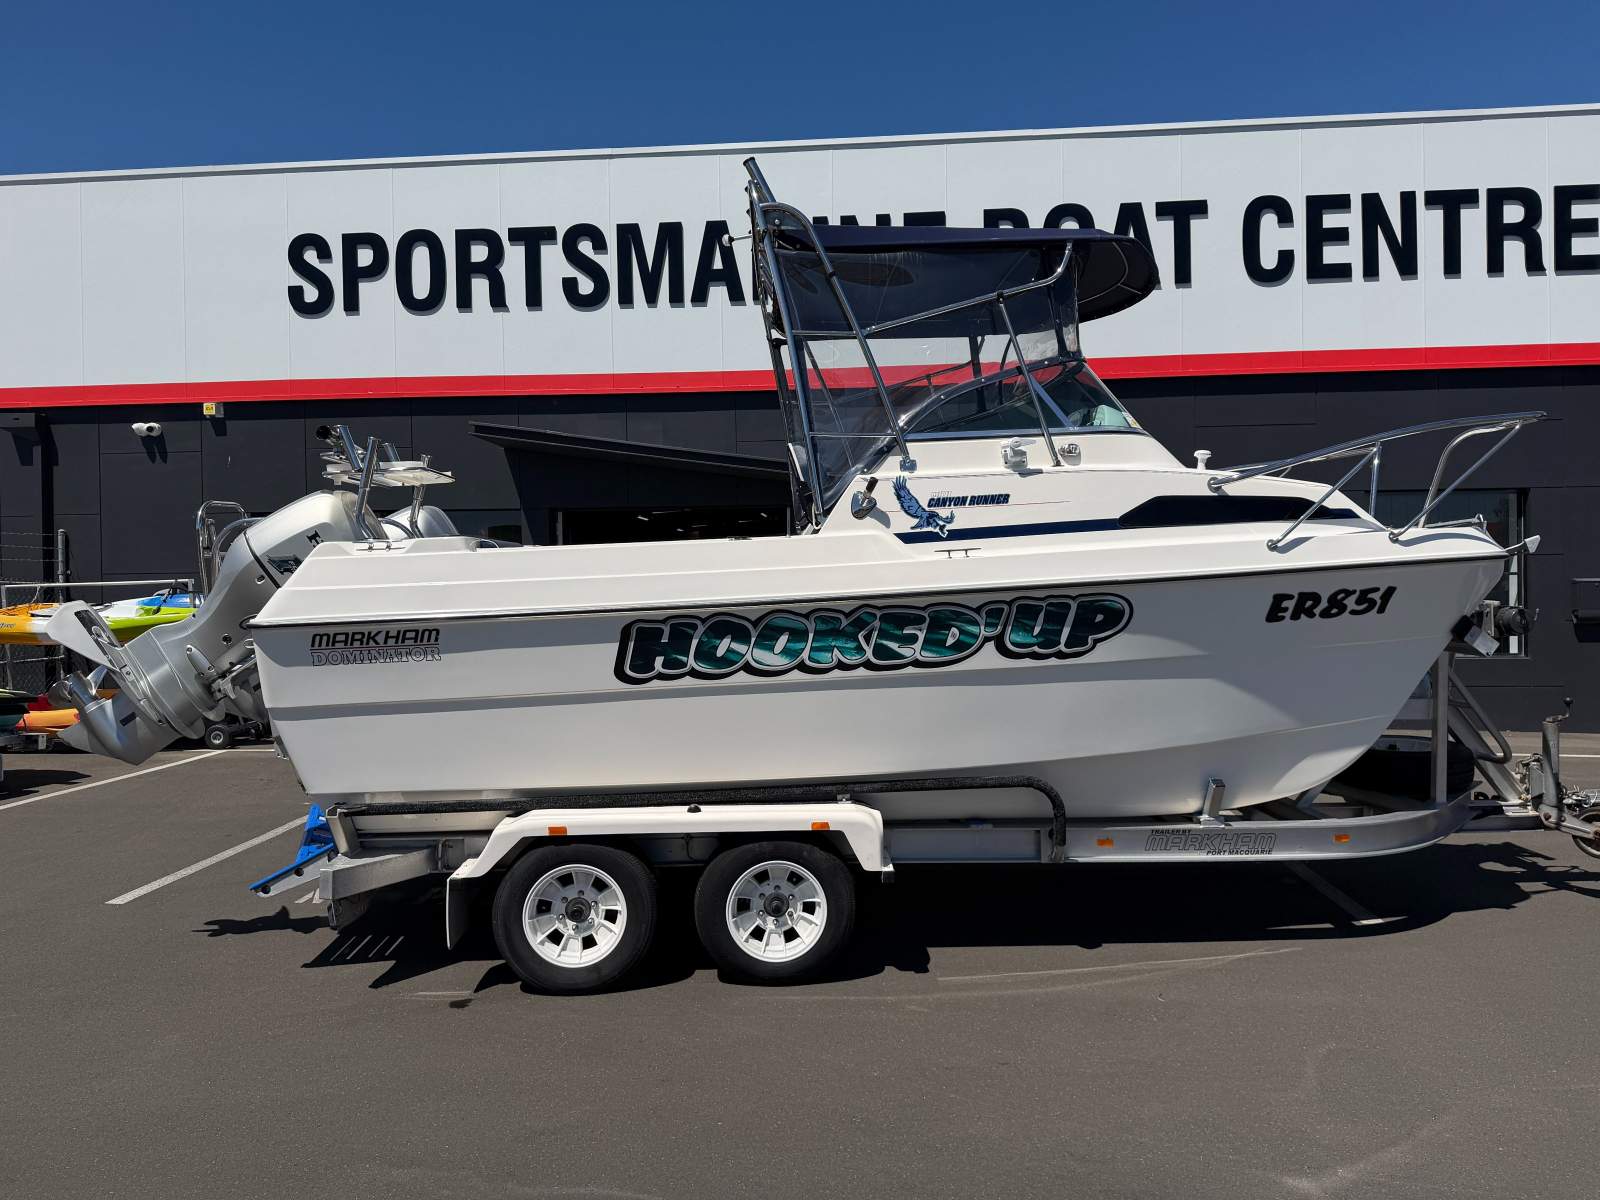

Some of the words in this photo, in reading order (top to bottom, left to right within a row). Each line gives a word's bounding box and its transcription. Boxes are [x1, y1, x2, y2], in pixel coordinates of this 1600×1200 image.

[287, 209, 946, 318] SPORTSMA
[1242, 184, 1600, 287] CENTRE
[927, 496, 969, 508] CANYON
[968, 494, 1010, 506] RUNNER
[1265, 586, 1397, 623] ER851
[310, 628, 440, 648] MARKHAM
[615, 595, 1131, 682] HOOKED'UP
[311, 647, 441, 666] DOMINATOR
[1144, 833, 1276, 851] MARKHAM
[1228, 848, 1273, 856] MACQUARIE
